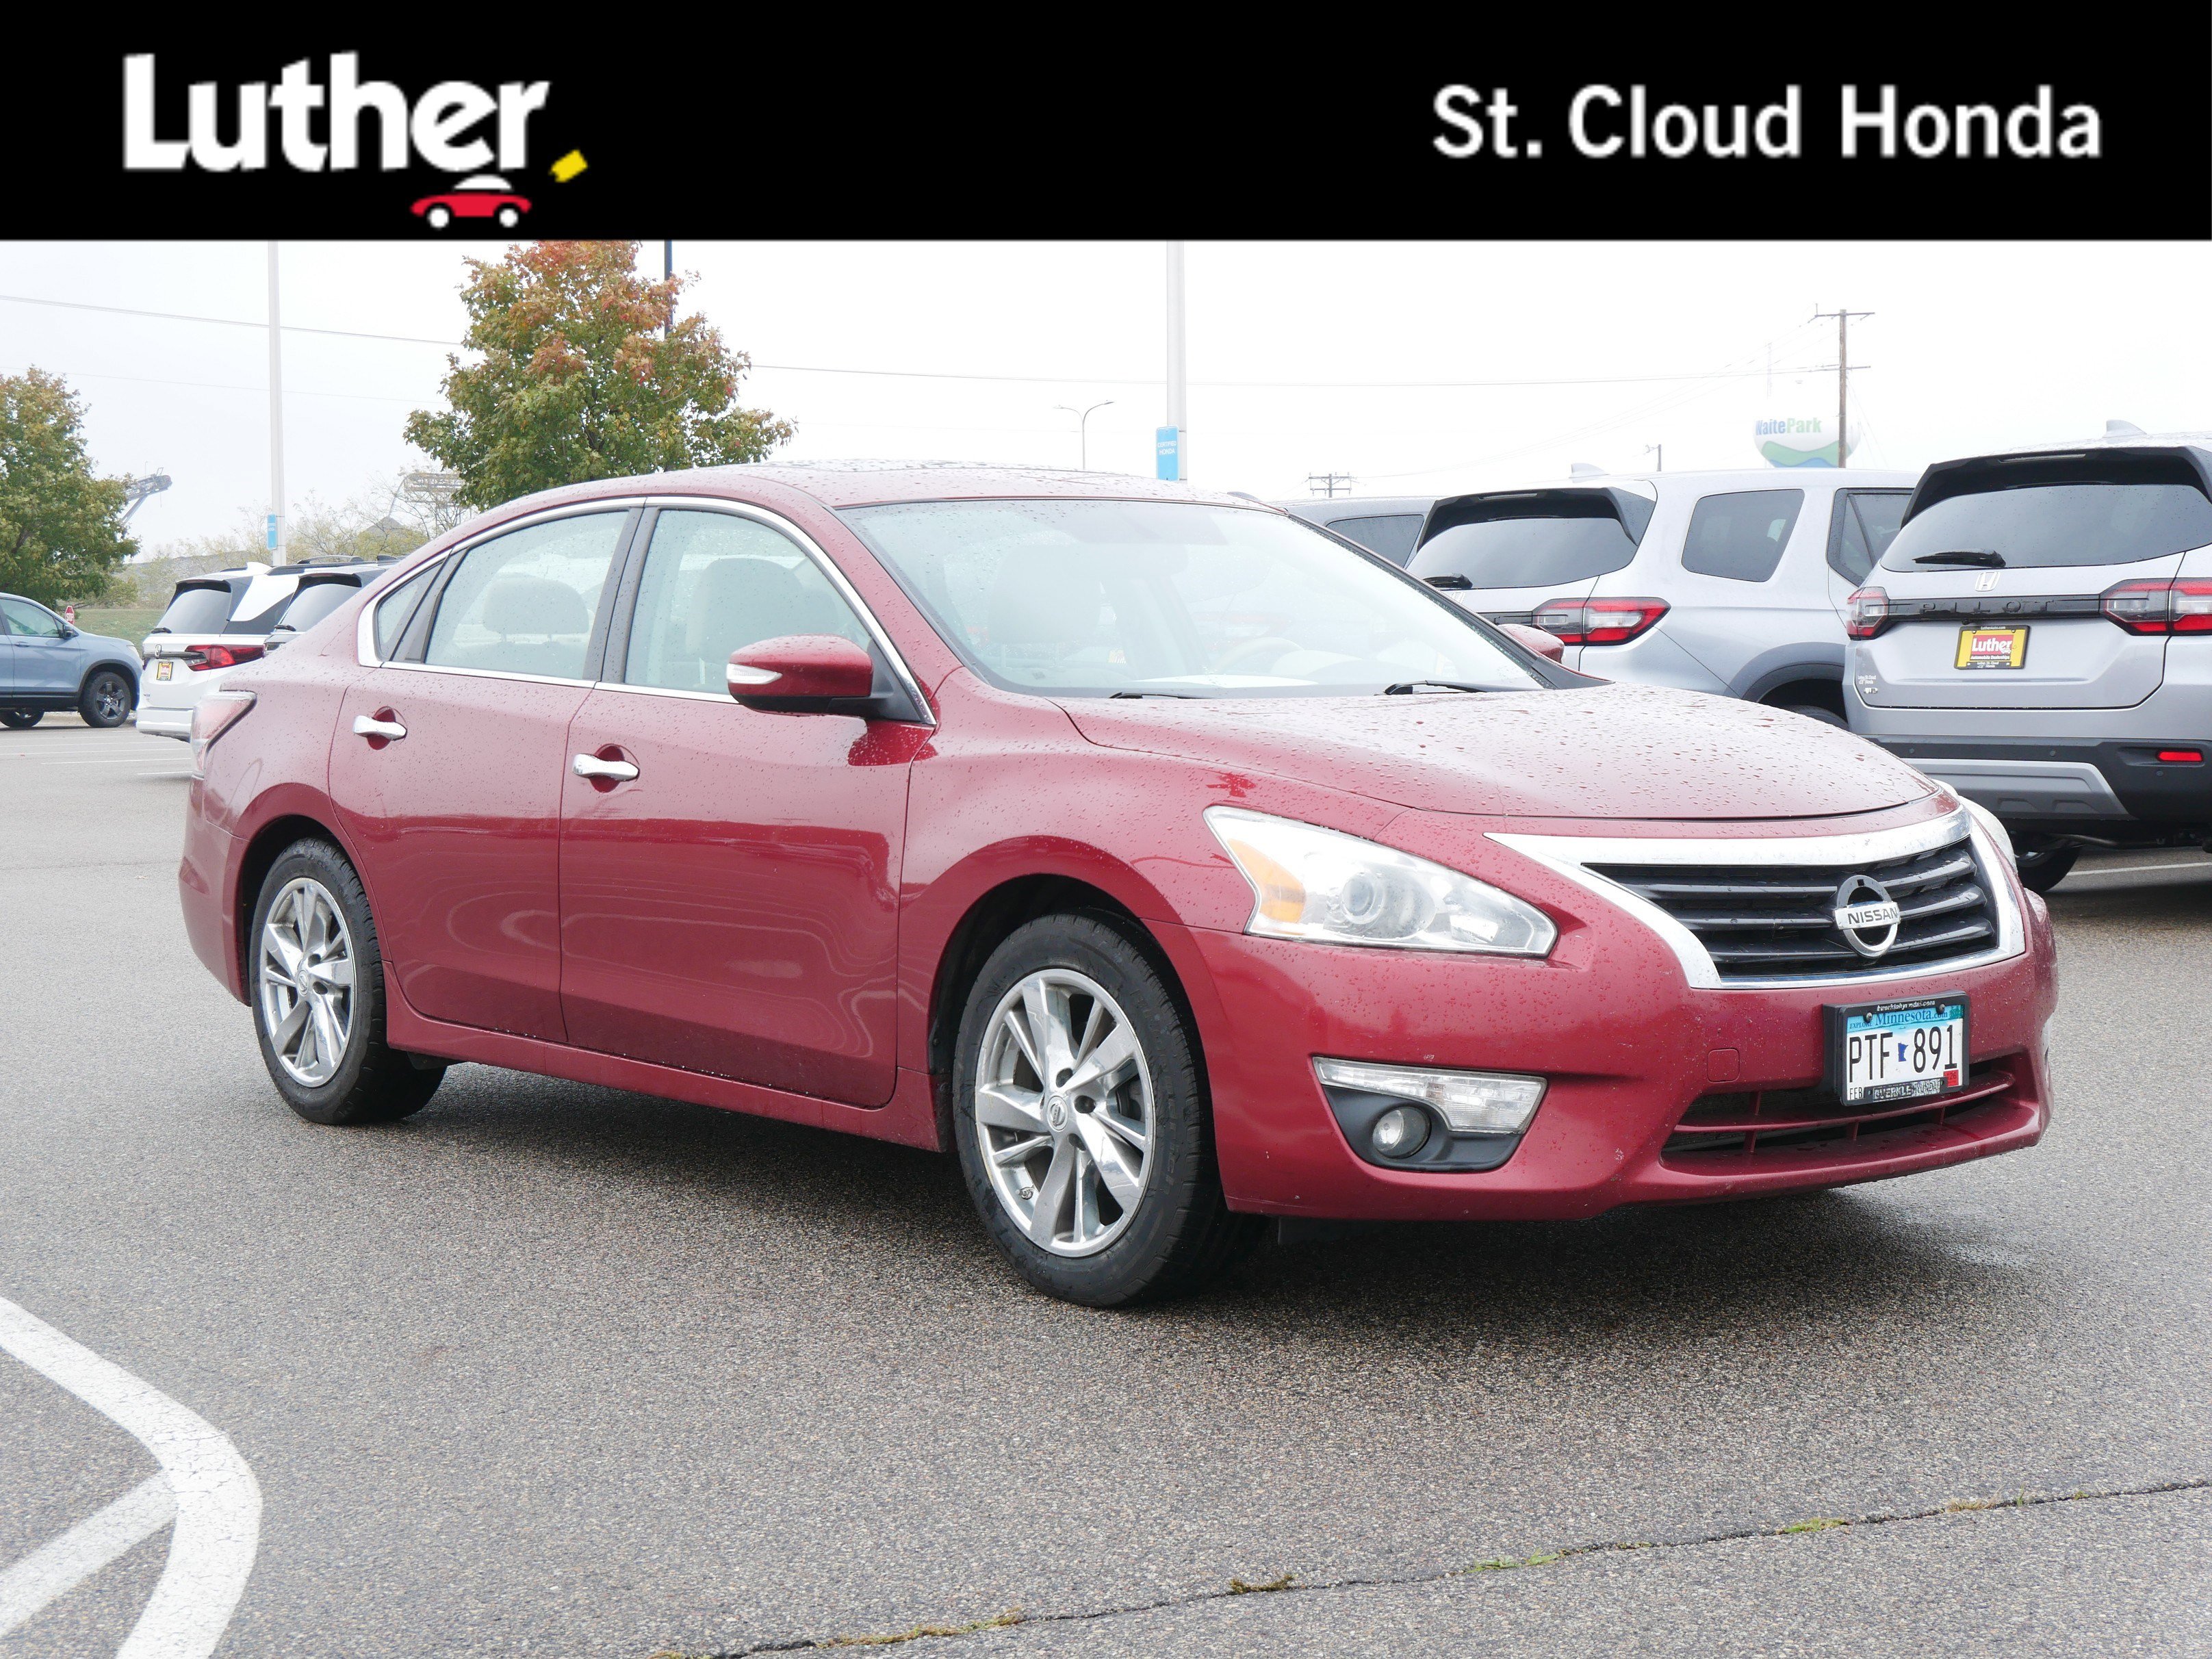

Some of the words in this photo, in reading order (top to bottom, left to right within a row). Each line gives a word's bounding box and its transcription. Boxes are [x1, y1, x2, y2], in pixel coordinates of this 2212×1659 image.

[1920, 599, 2054, 614] PILOT
[1972, 637, 2013, 652] Luther
[1847, 907, 1898, 925] NISSAN
[1849, 1020, 1872, 1029] EXPLORE
[1849, 1031, 1893, 1083] PTF
[1914, 1025, 1957, 1073] 891
[1849, 1087, 1863, 1101] FEB
